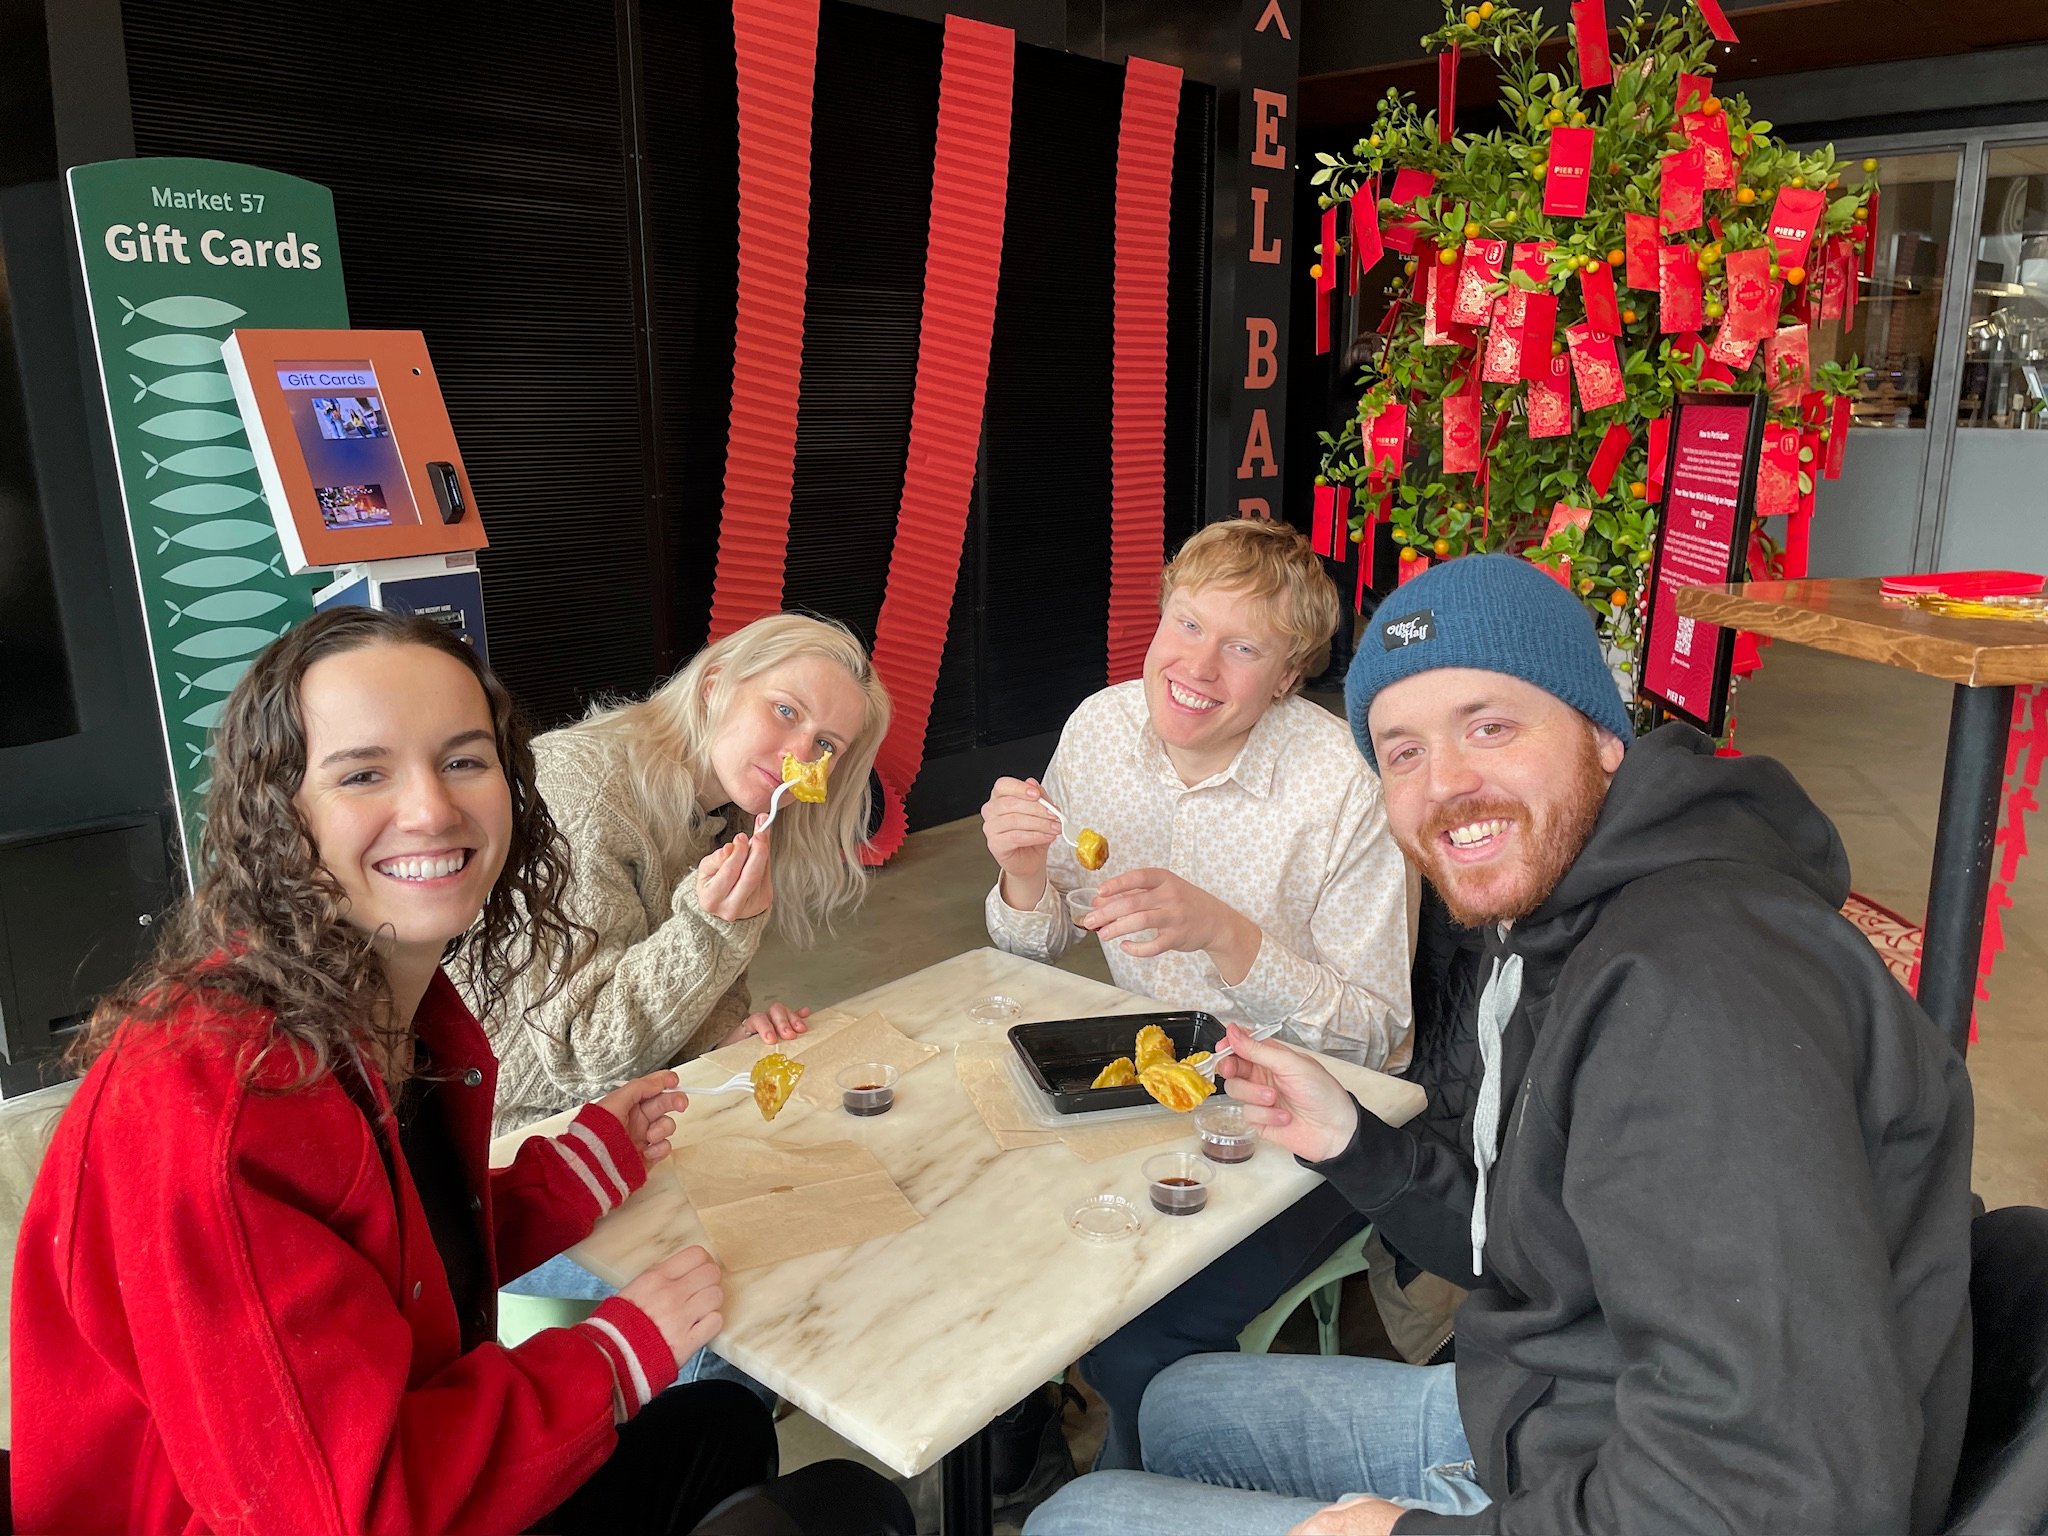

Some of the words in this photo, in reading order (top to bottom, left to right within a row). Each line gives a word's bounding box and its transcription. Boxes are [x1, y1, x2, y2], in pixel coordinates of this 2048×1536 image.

[1249, 87, 1287, 264] EL
[1554, 166, 1573, 175] PIER
[152, 186, 233, 212] Market
[240, 193, 265, 214] 57
[1773, 226, 1795, 238] PIER
[1795, 229, 1807, 239] 57
[104, 222, 191, 265] Gift
[200, 232, 322, 270] Cards
[288, 373, 316, 386] Gift
[319, 373, 366, 386] Cards
[1386, 616, 1420, 637] Other
[1400, 624, 1429, 646] Half
[1666, 688, 1679, 704] PIER
